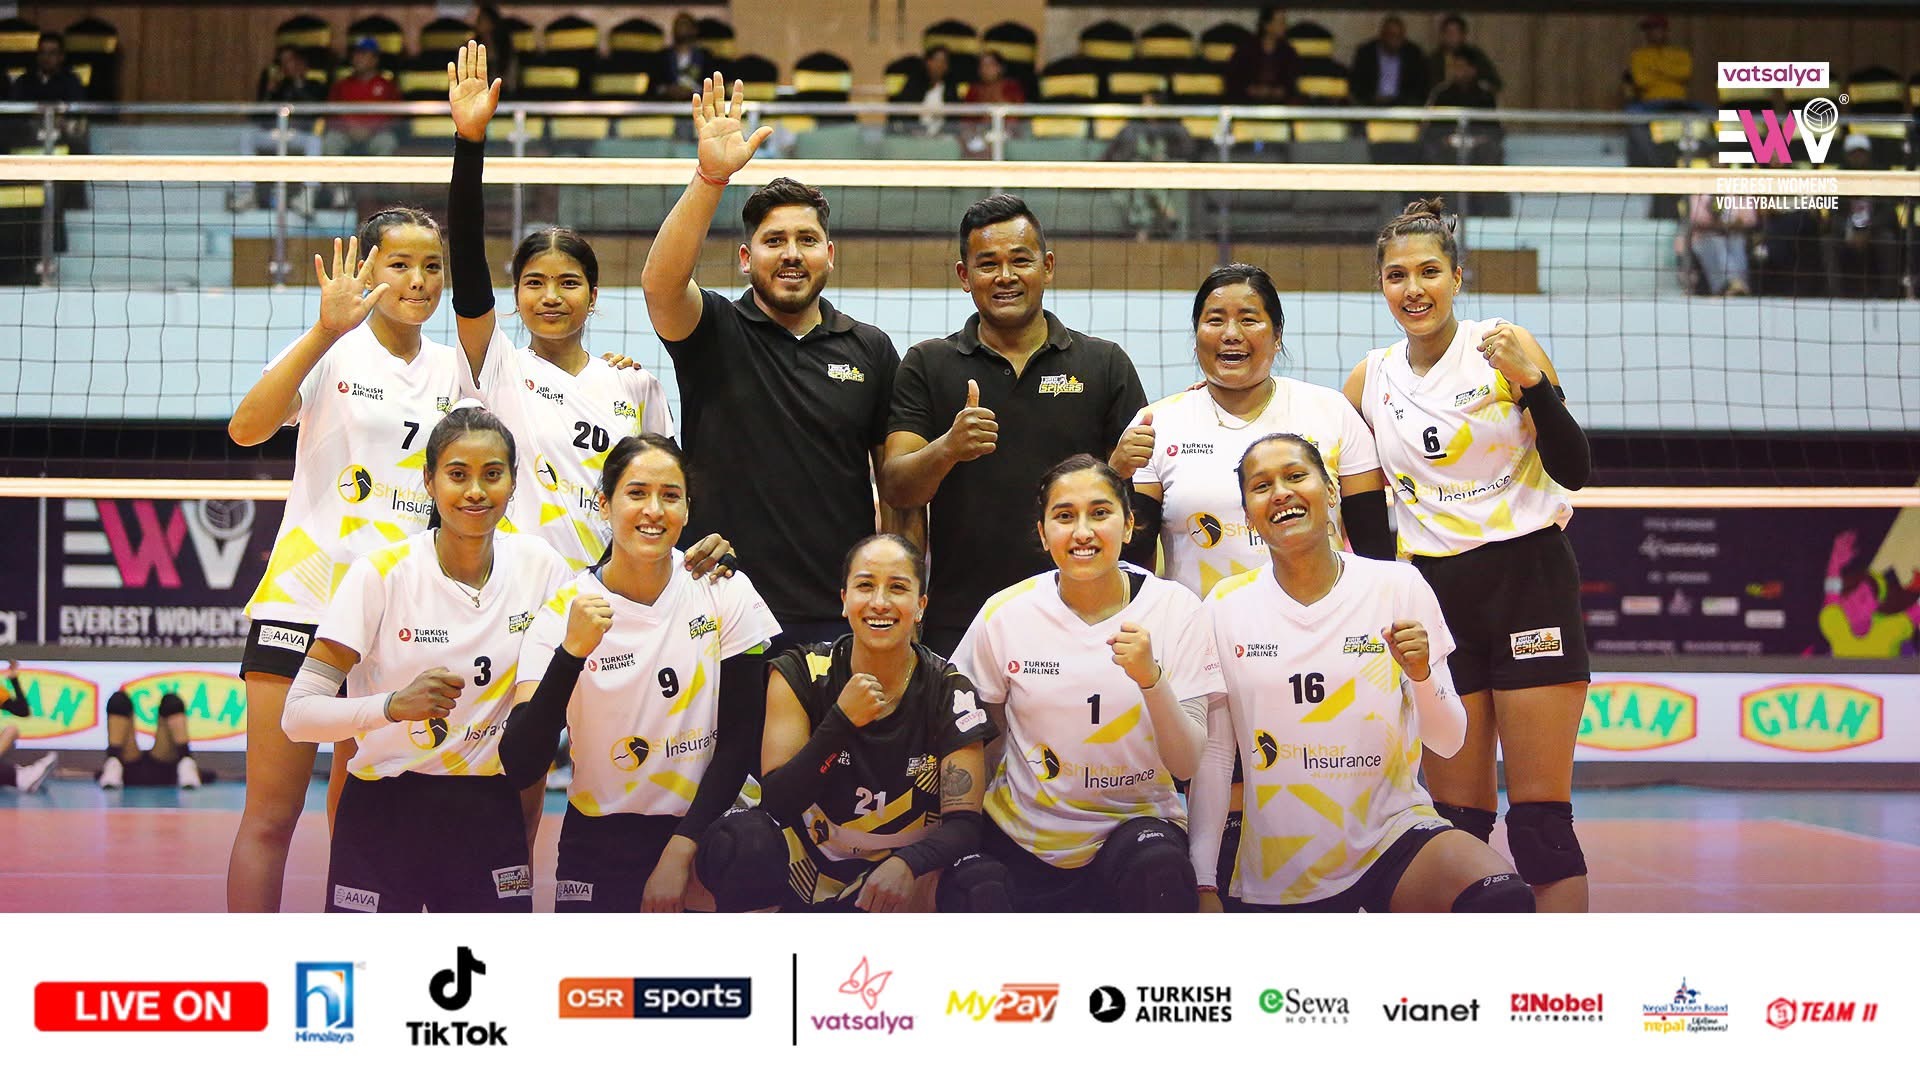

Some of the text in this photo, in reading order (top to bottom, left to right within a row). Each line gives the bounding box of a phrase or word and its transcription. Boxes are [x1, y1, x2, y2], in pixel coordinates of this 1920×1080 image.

[1040, 383, 1084, 393] SPIKERS
[400, 420, 420, 450] 7
[572, 421, 610, 453] 20
[1422, 426, 1441, 453] 6
[1181, 442, 1214, 450] TURKISH
[60, 604, 152, 636] EVEREST
[272, 630, 305, 647] AAVA
[413, 636, 450, 644] AIRLINES
[414, 628, 449, 636] TURKISH
[1246, 643, 1279, 651] TURKISH
[1246, 650, 1279, 658] AIRLINES
[1343, 642, 1385, 655] SPIKERS
[1514, 640, 1561, 655] SPIKERS
[599, 652, 635, 665] TURKISH
[600, 659, 637, 672] AIRLINES
[1022, 660, 1060, 668] TURKISH
[473, 655, 492, 687] 3
[1022, 667, 1060, 676] AIRLINES
[657, 666, 680, 699] 9
[1288, 671, 1326, 705] 16
[1086, 693, 1101, 725] 1
[1751, 690, 1871, 739] GYAN
[1280, 743, 1348, 760] Shikhar
[1303, 747, 1382, 770] Insurance
[1084, 766, 1155, 789] Insurance
[853, 786, 887, 819] 21
[562, 883, 590, 895] AAVA
[344, 891, 376, 906] AAVA
